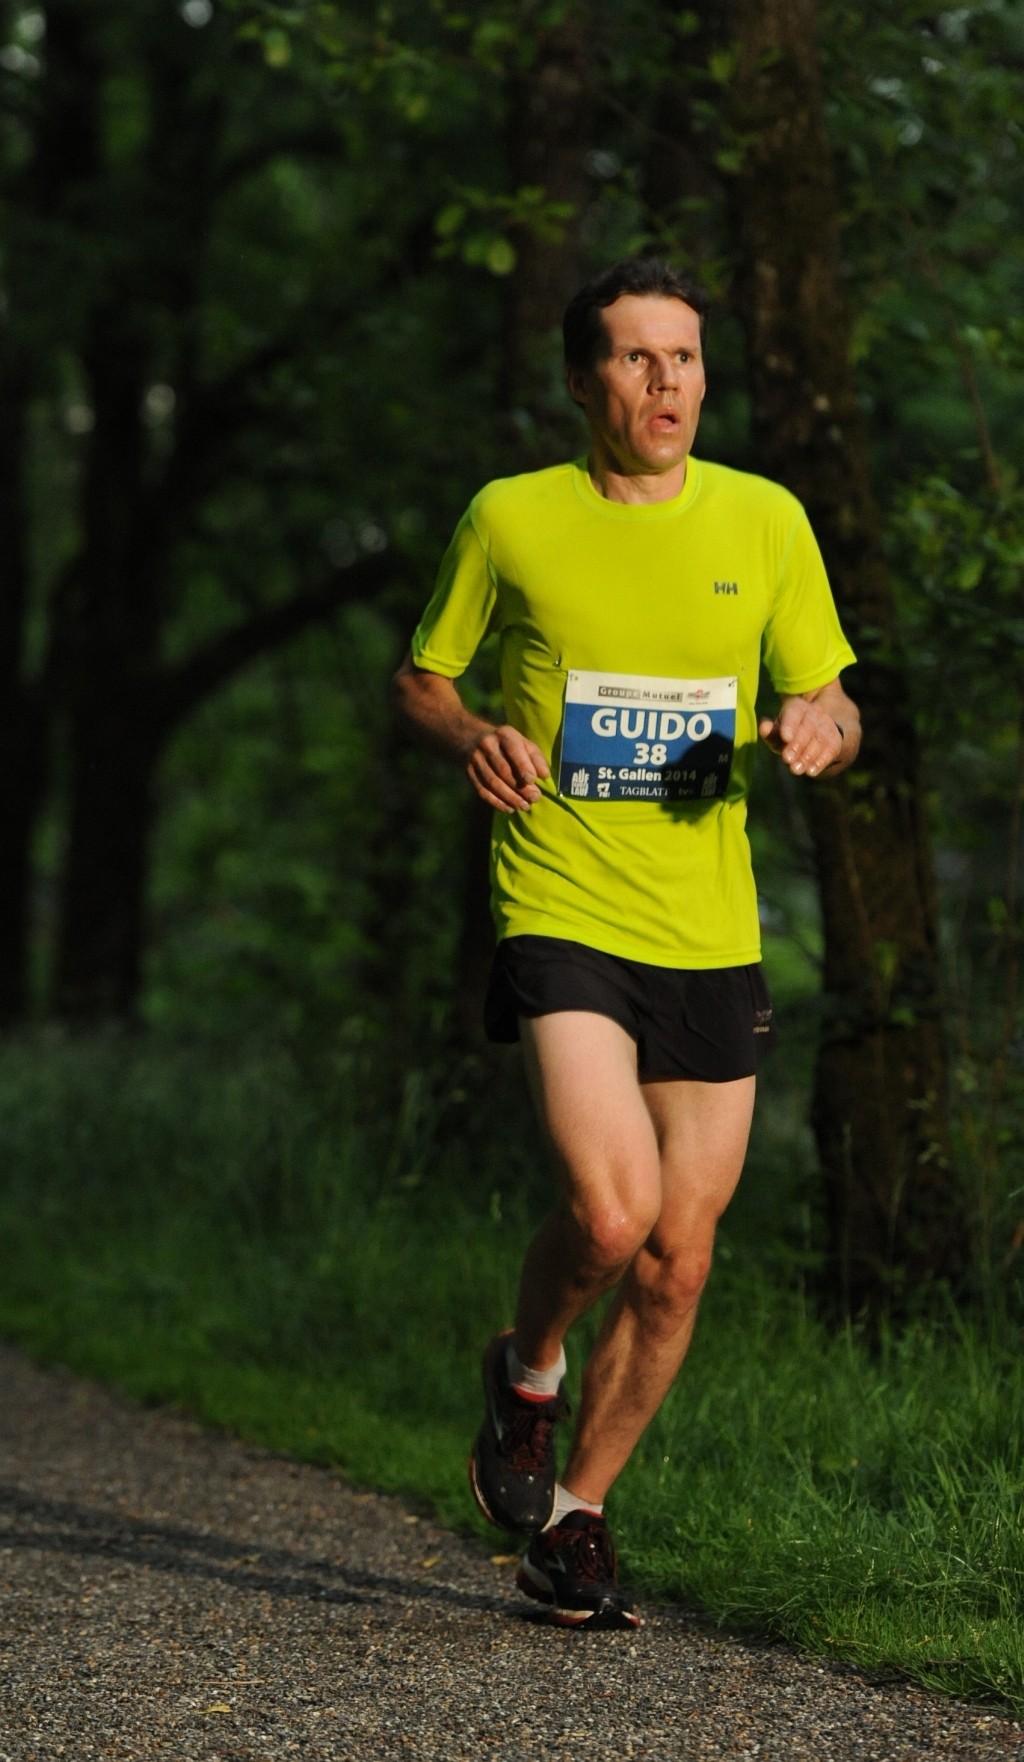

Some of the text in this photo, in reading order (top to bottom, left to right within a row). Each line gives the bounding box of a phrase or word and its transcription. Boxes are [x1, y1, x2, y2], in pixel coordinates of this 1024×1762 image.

[600, 687, 639, 699] Groupe
[642, 691, 681, 701] Mutuel
[591, 708, 712, 741] GUIDO
[633, 742, 667, 766] 38
[598, 767, 697, 781] St. Gallen 2014
[620, 786, 668, 797] TAGBLATT
